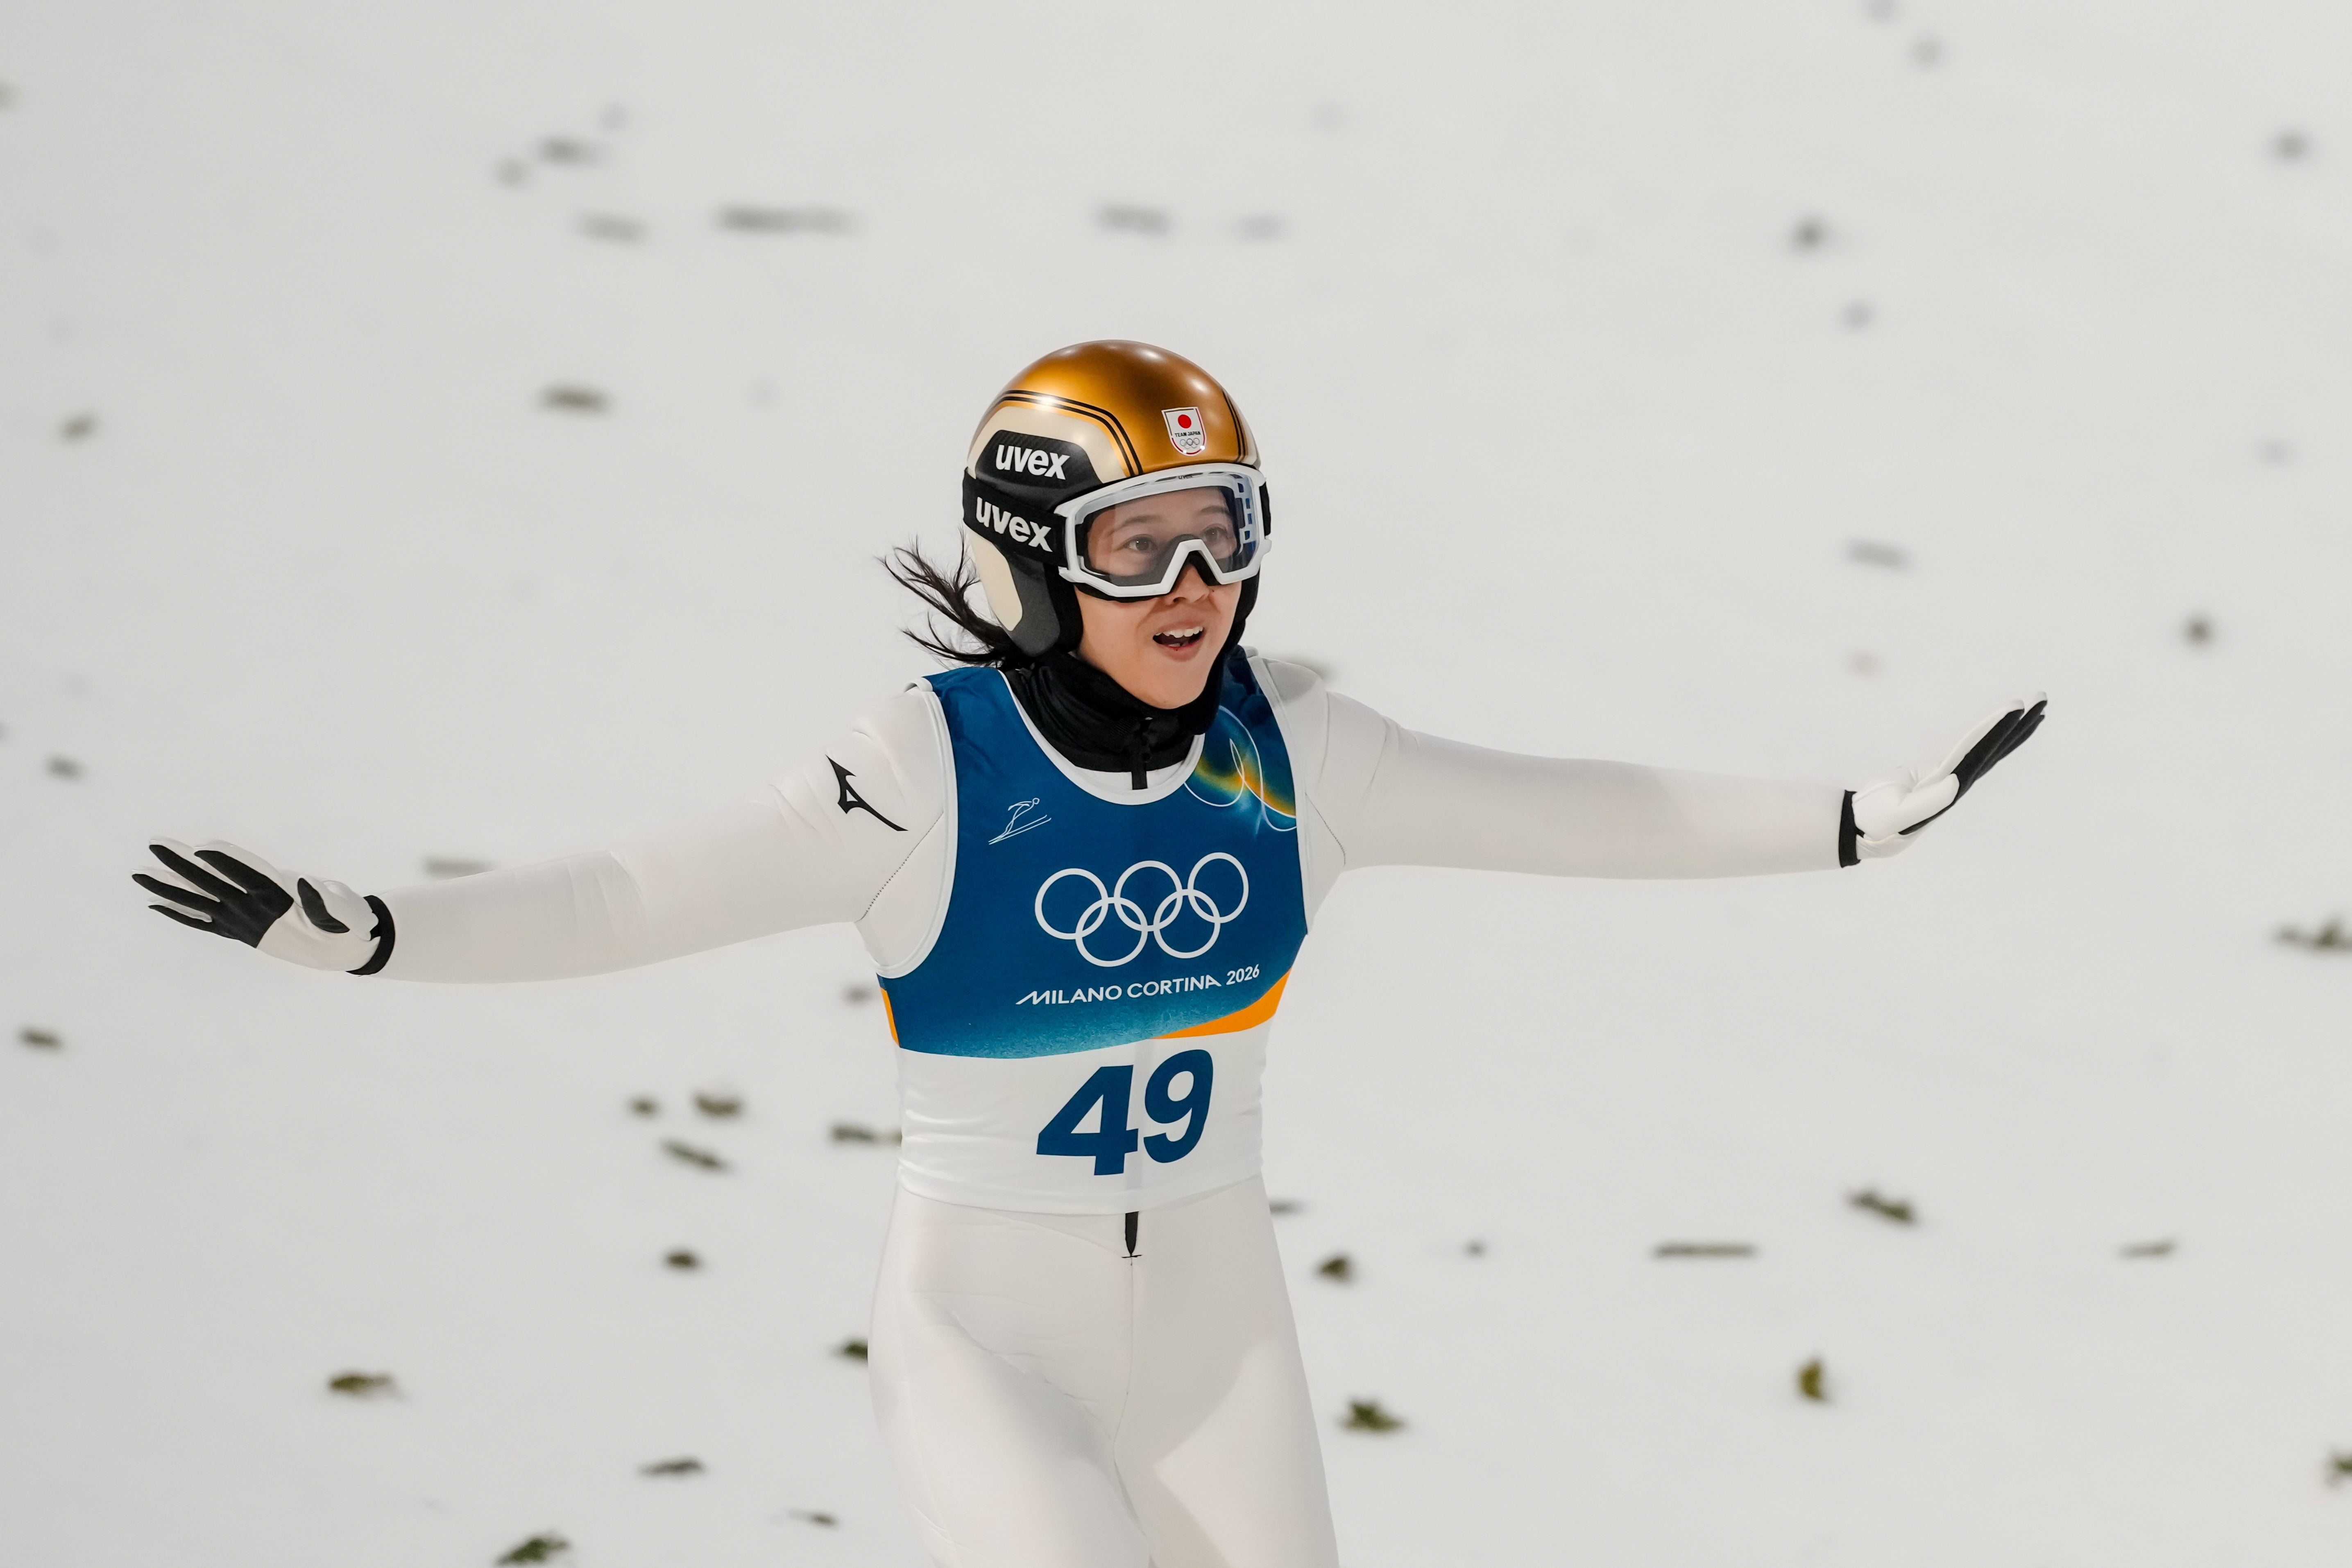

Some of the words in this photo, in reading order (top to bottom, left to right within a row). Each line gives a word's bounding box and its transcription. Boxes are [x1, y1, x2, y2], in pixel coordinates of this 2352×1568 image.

[996, 444, 1070, 480] uvex
[976, 497, 1053, 552] uvex
[1015, 986, 1122, 1005] MILANO
[1127, 975, 1221, 998] CORTINA
[1226, 964, 1260, 985] 2026
[1036, 1049, 1214, 1176] 49
